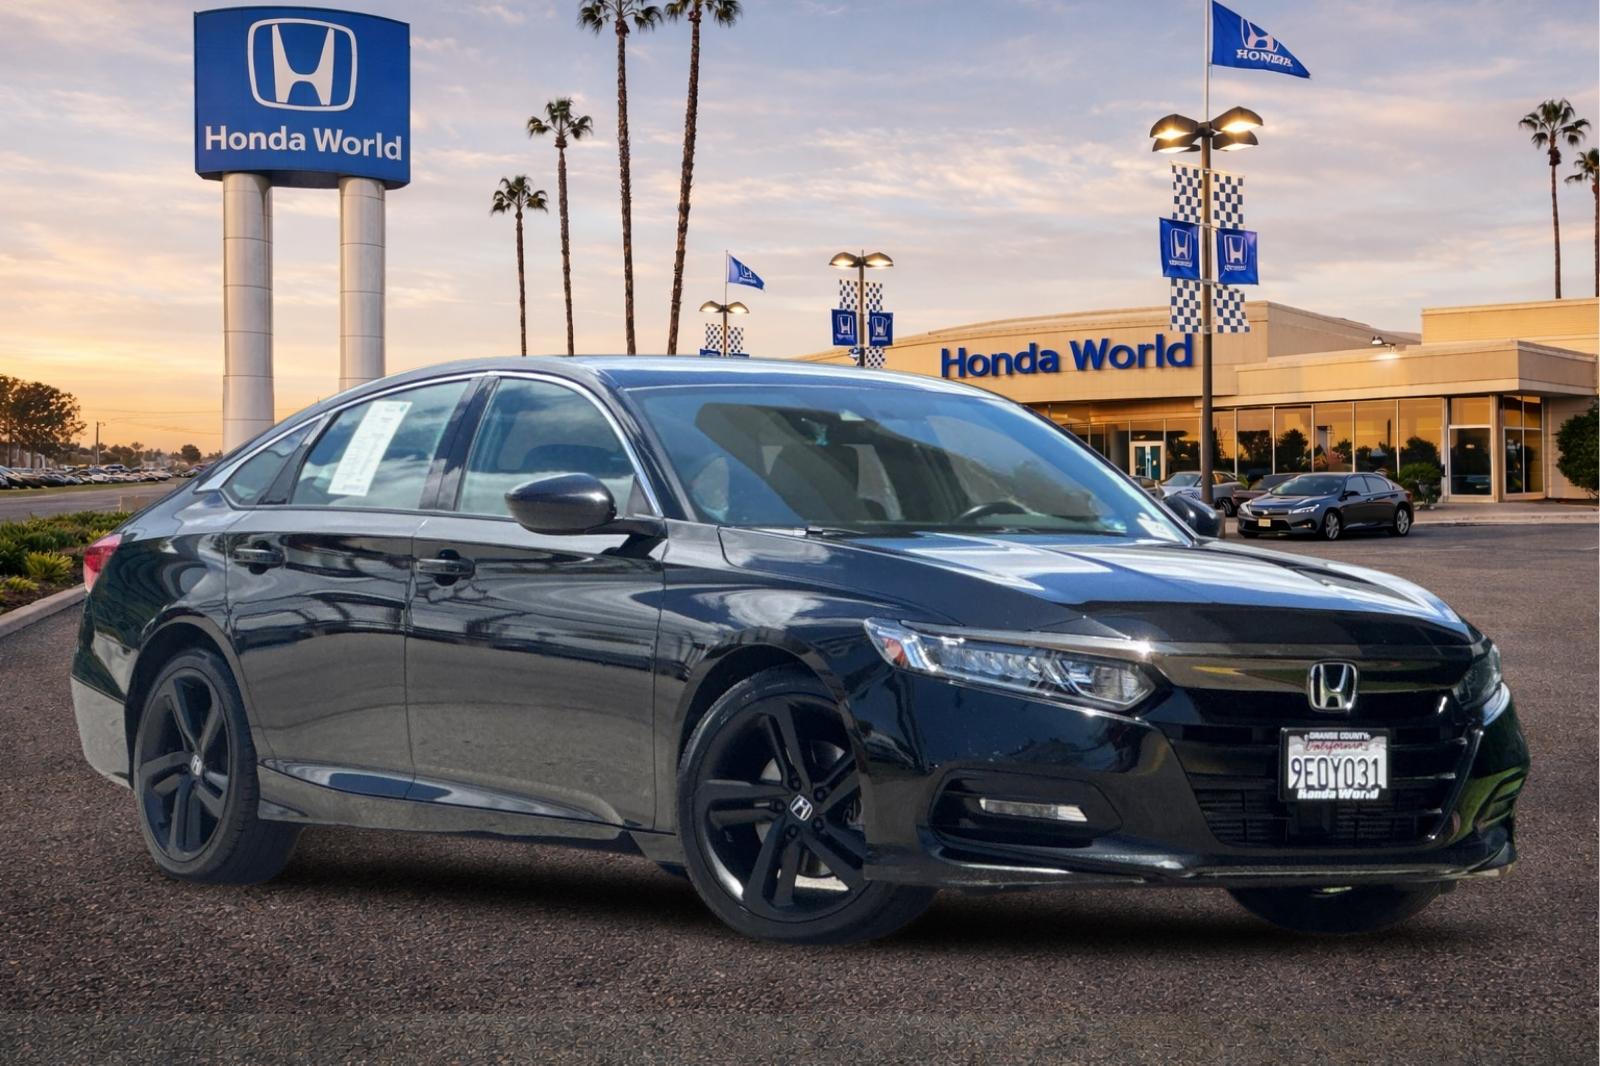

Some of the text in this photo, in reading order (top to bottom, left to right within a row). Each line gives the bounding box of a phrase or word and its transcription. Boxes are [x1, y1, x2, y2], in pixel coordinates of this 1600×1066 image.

[205, 125, 402, 161] Honda World
[941, 333, 1193, 378] Honda World
